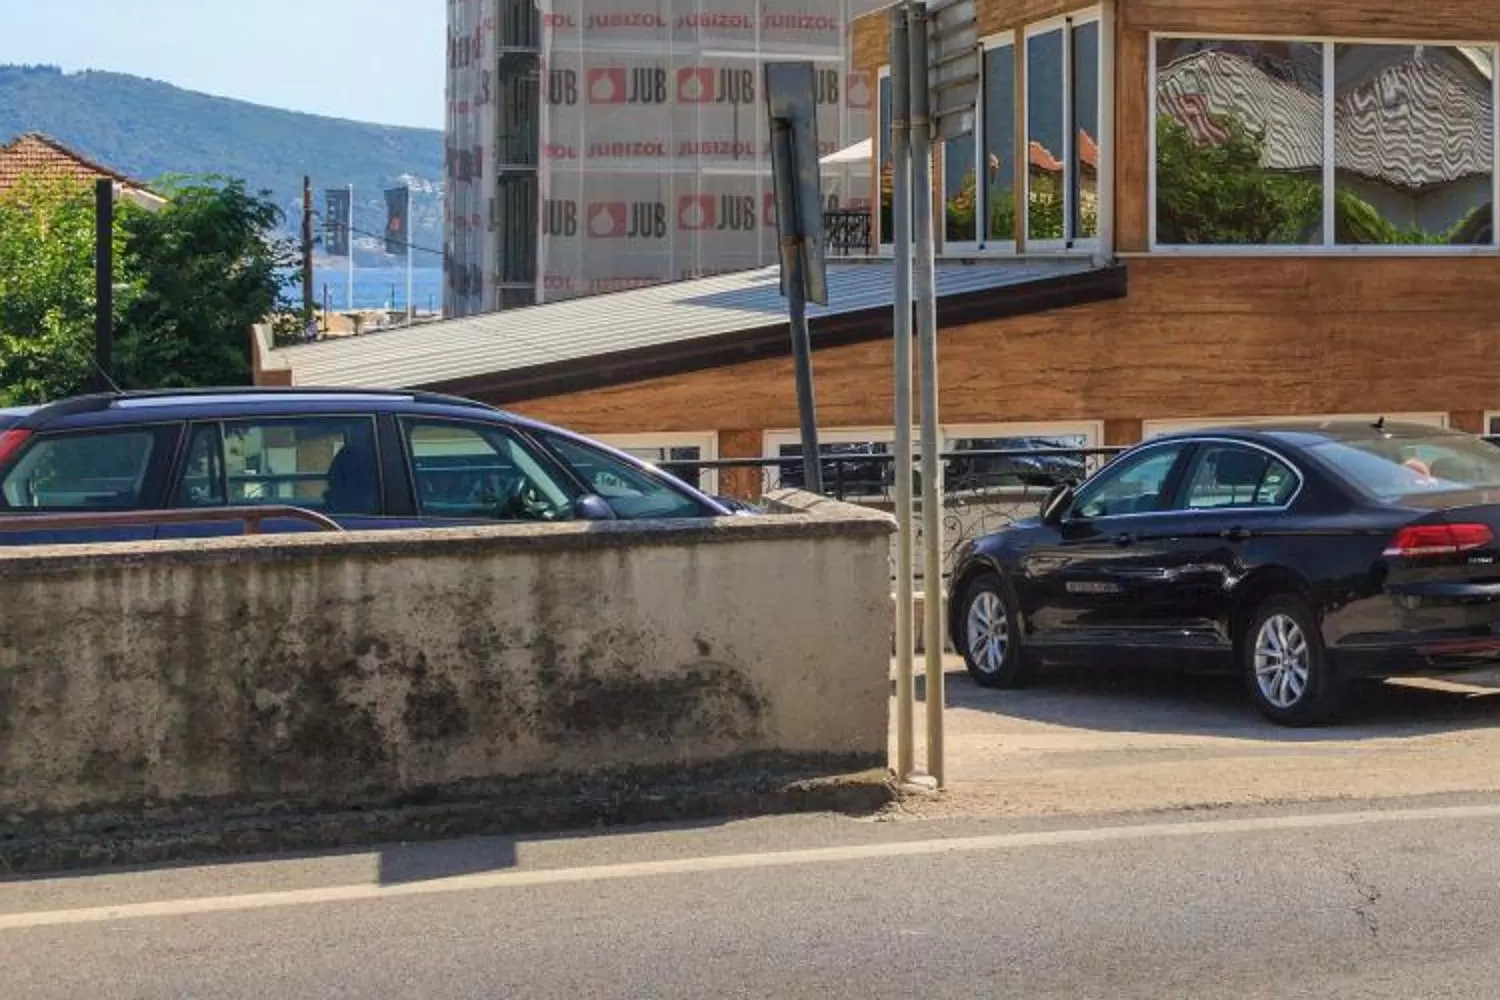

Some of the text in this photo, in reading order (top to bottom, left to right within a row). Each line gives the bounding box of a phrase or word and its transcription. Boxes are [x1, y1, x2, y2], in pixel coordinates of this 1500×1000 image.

[587, 12, 667, 29] JUBIZOL
[677, 12, 753, 30] JUBIZOL
[628, 66, 667, 105] JUB
[715, 67, 755, 105] JUB
[627, 200, 667, 239] JUB
[716, 193, 757, 231] JUB
